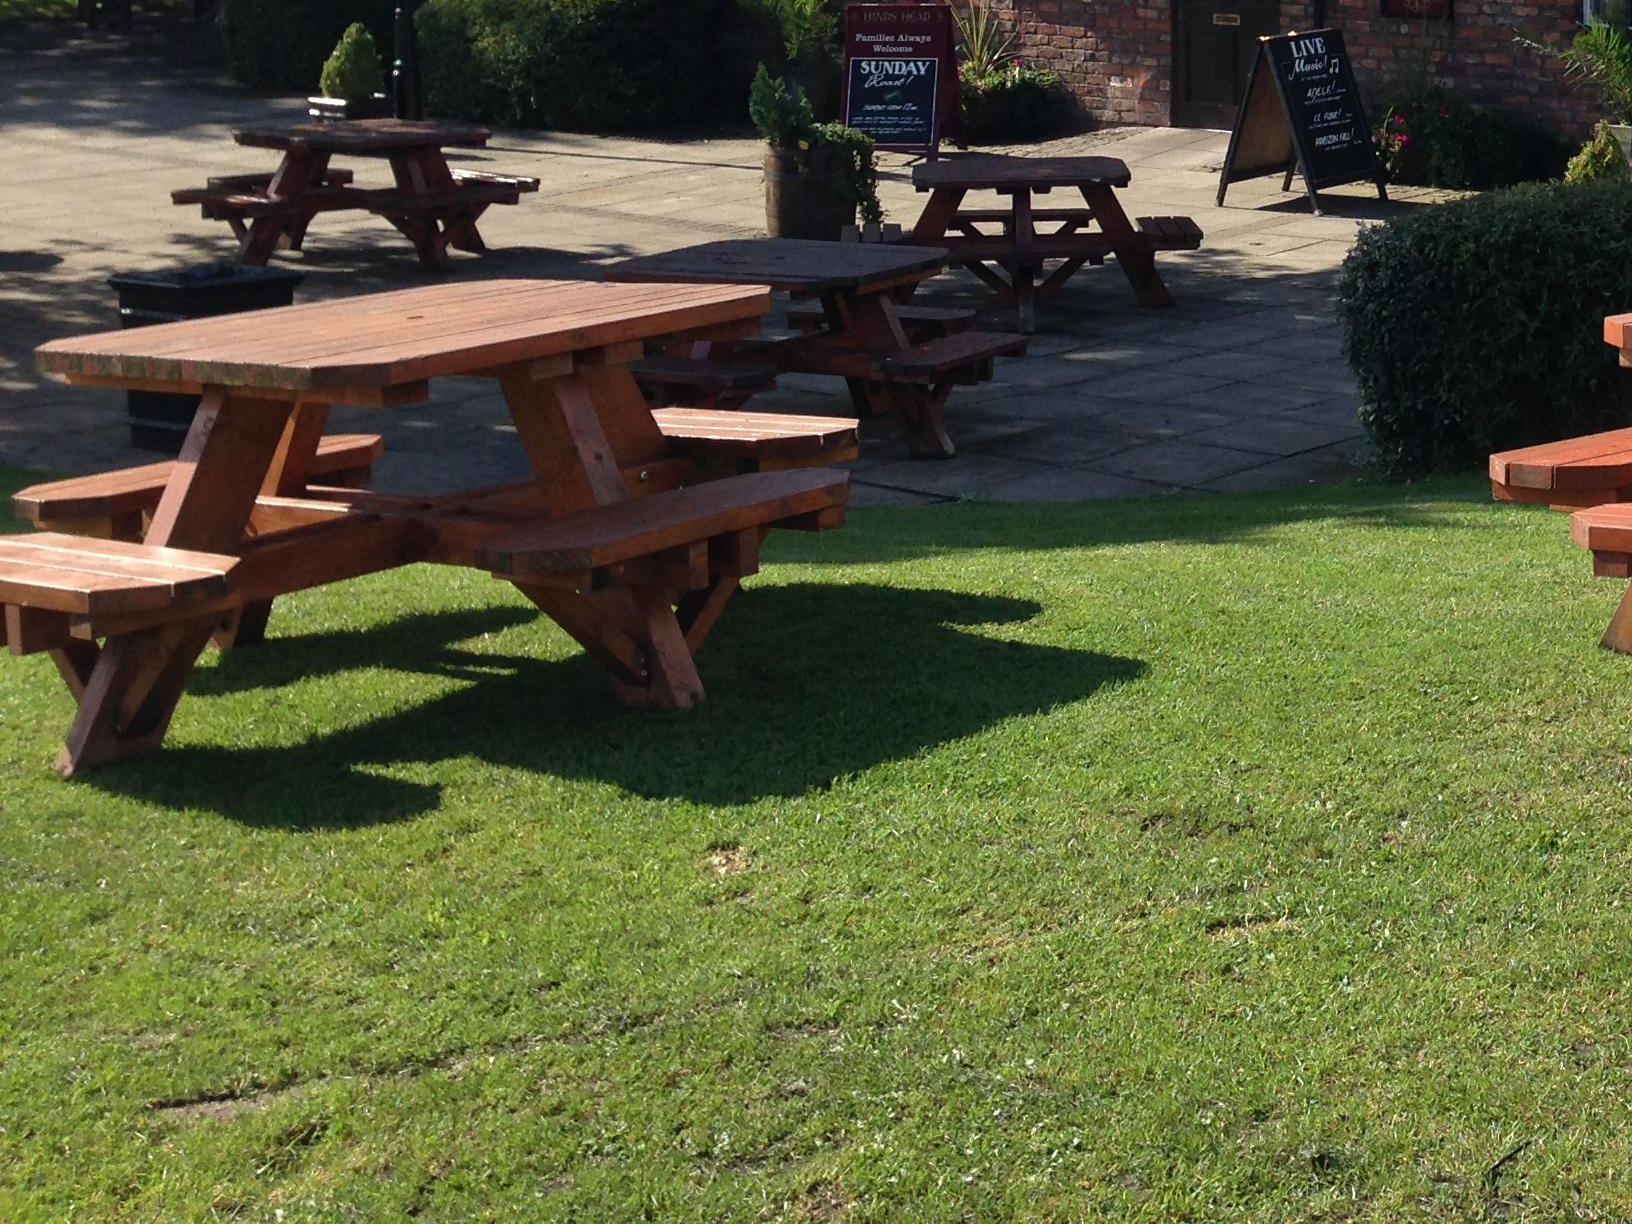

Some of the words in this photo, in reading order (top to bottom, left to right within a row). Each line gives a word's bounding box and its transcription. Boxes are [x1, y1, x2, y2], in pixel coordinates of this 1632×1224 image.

[855, 33, 895, 42] Families
[897, 34, 932, 44] Always
[873, 44, 913, 53] Welcome
[1289, 37, 1326, 58] LIVE
[860, 61, 930, 75] SUNDAY
